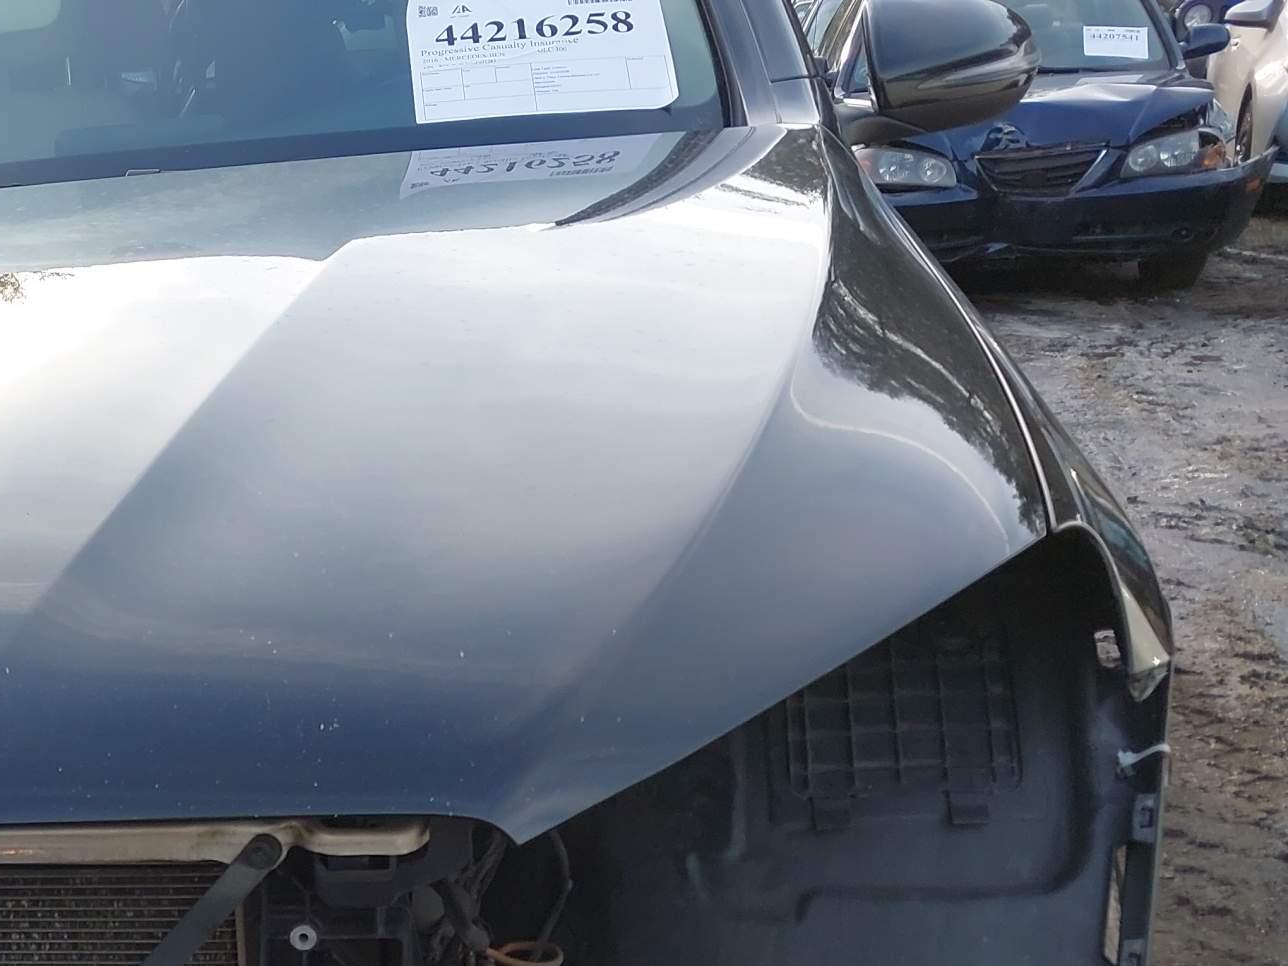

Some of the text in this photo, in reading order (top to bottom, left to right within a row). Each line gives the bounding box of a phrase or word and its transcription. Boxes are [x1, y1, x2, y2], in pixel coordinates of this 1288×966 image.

[434, 11, 634, 46] 44216258
[421, 46, 479, 57] Progressive
[481, 39, 526, 49] Casualty
